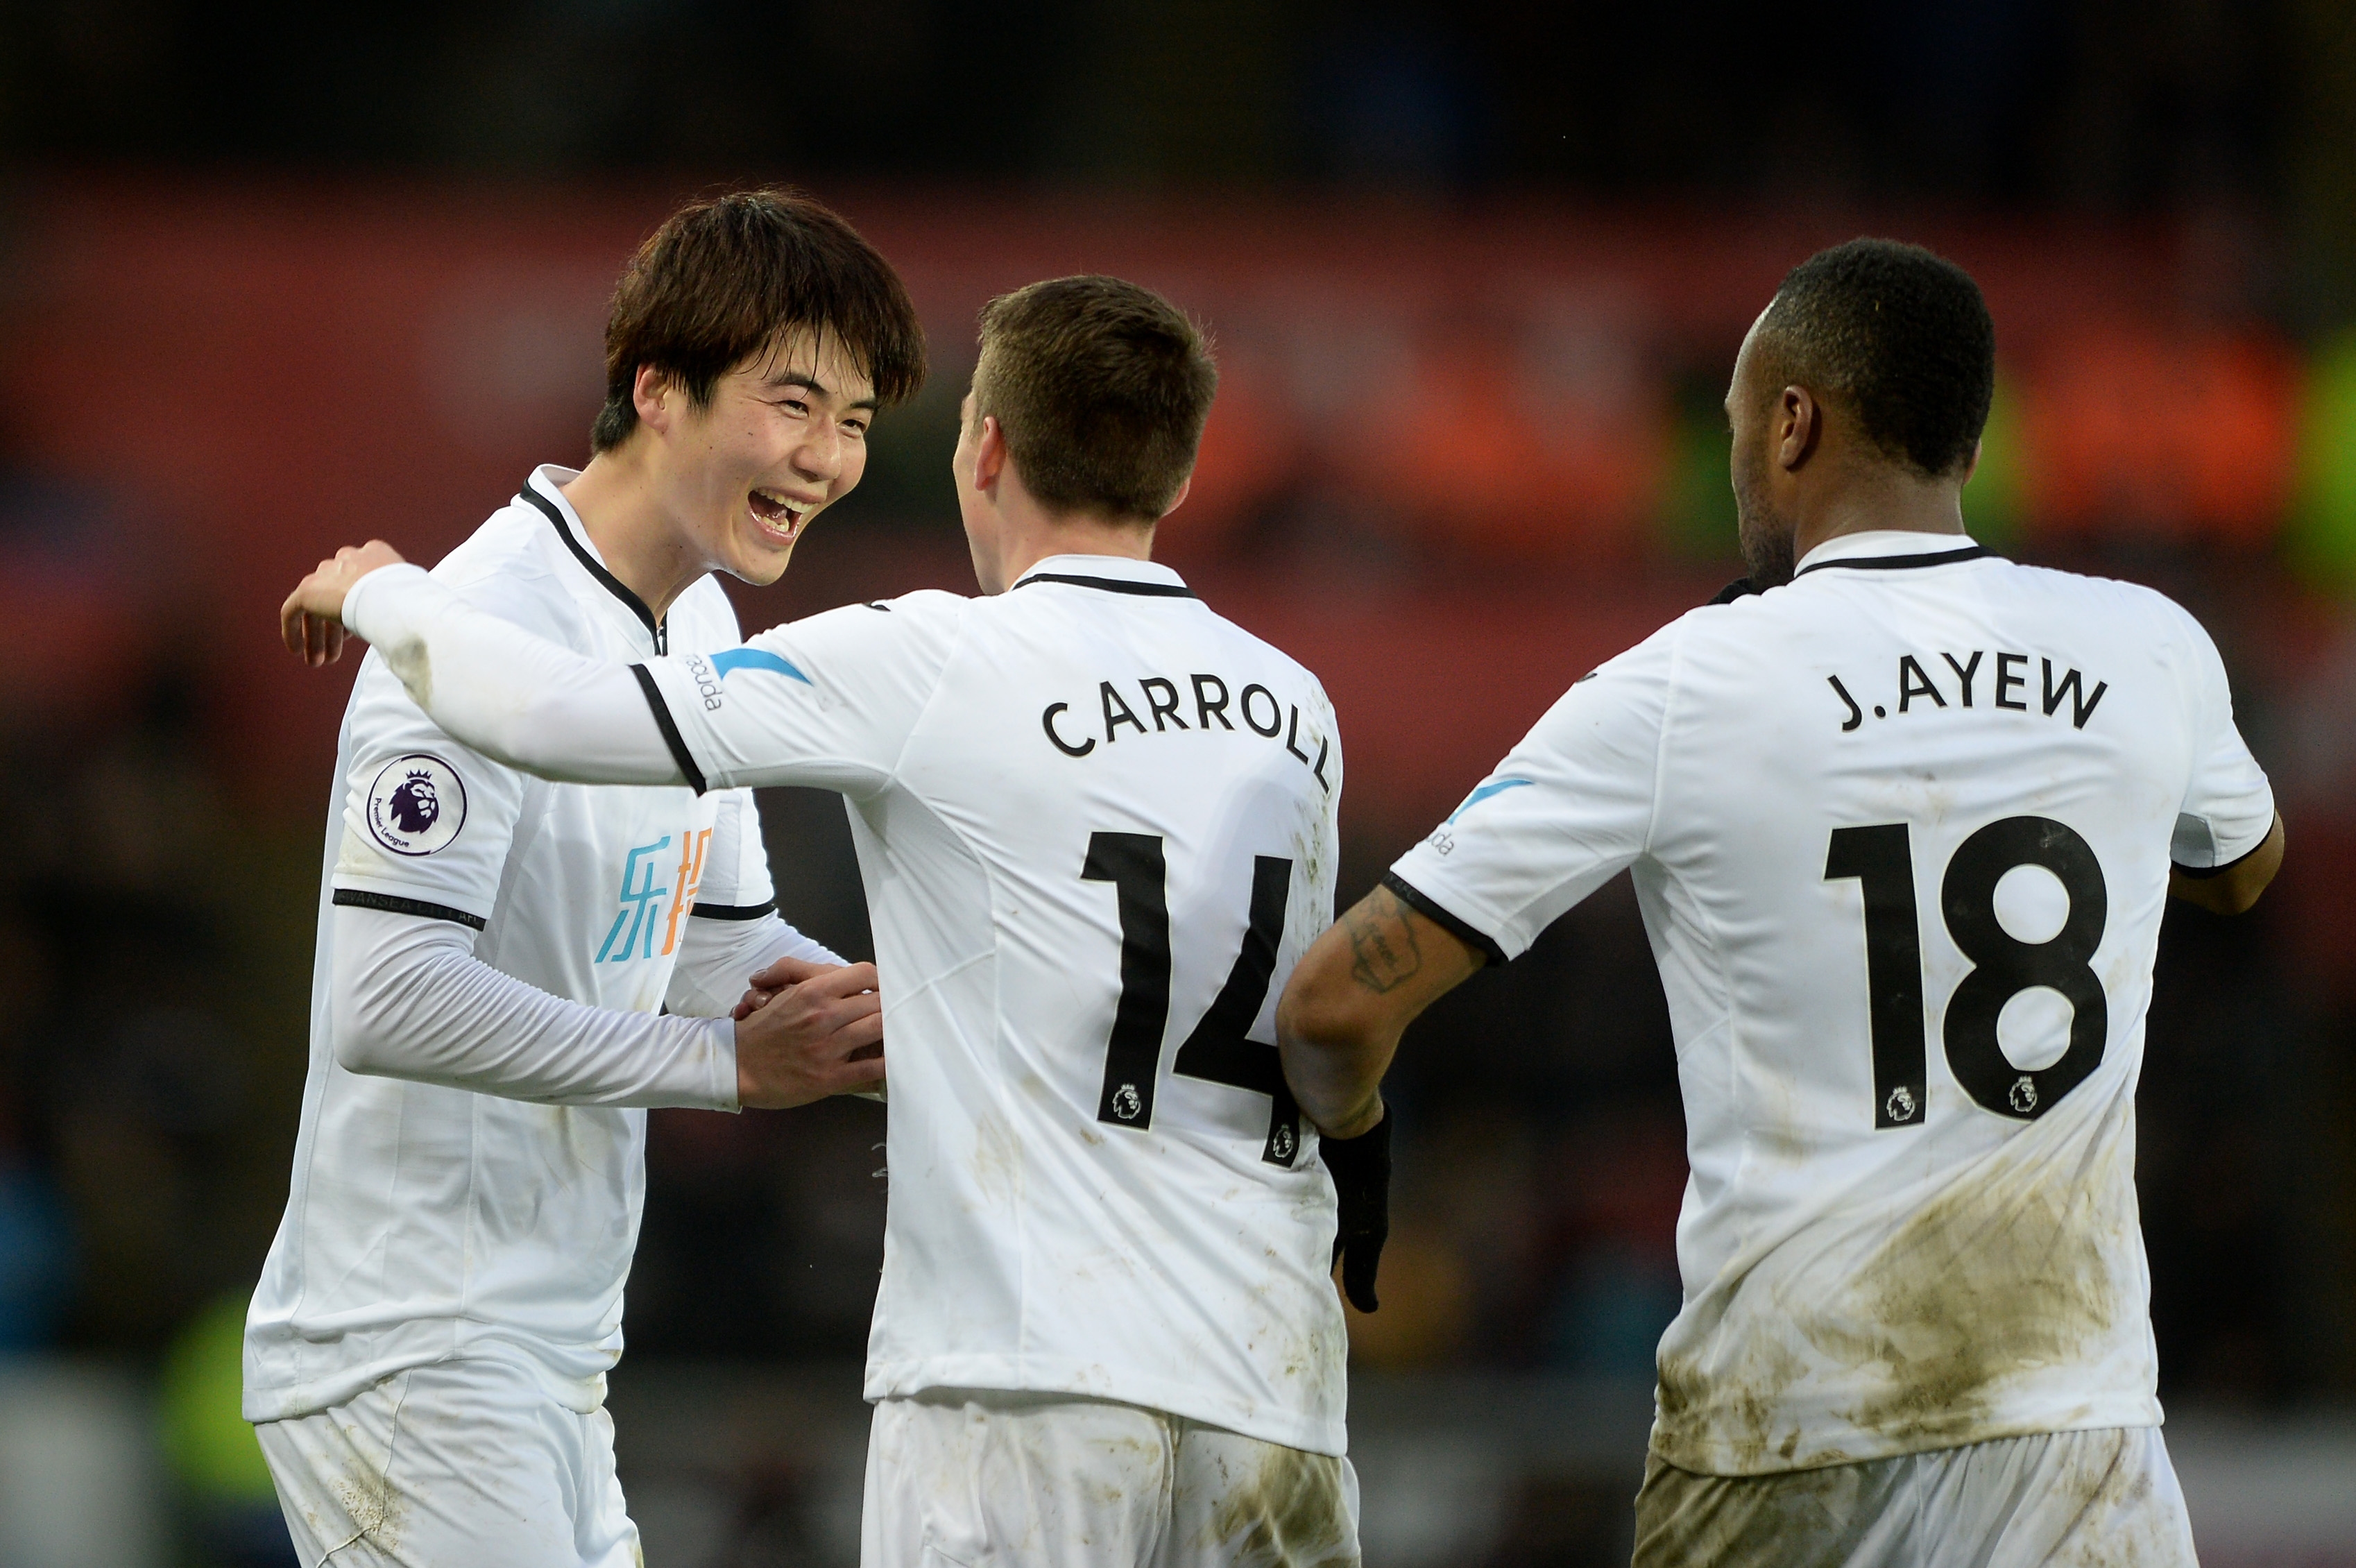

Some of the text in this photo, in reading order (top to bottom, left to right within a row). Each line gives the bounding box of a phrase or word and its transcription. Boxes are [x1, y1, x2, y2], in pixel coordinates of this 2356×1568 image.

[685, 654, 723, 711] acuda
[1827, 651, 2109, 733] J.AYEW
[1042, 673, 1331, 795] CARROLL
[374, 798, 409, 846] Premier League
[1080, 831, 1301, 1169] 14
[1823, 815, 2108, 1130] 18
